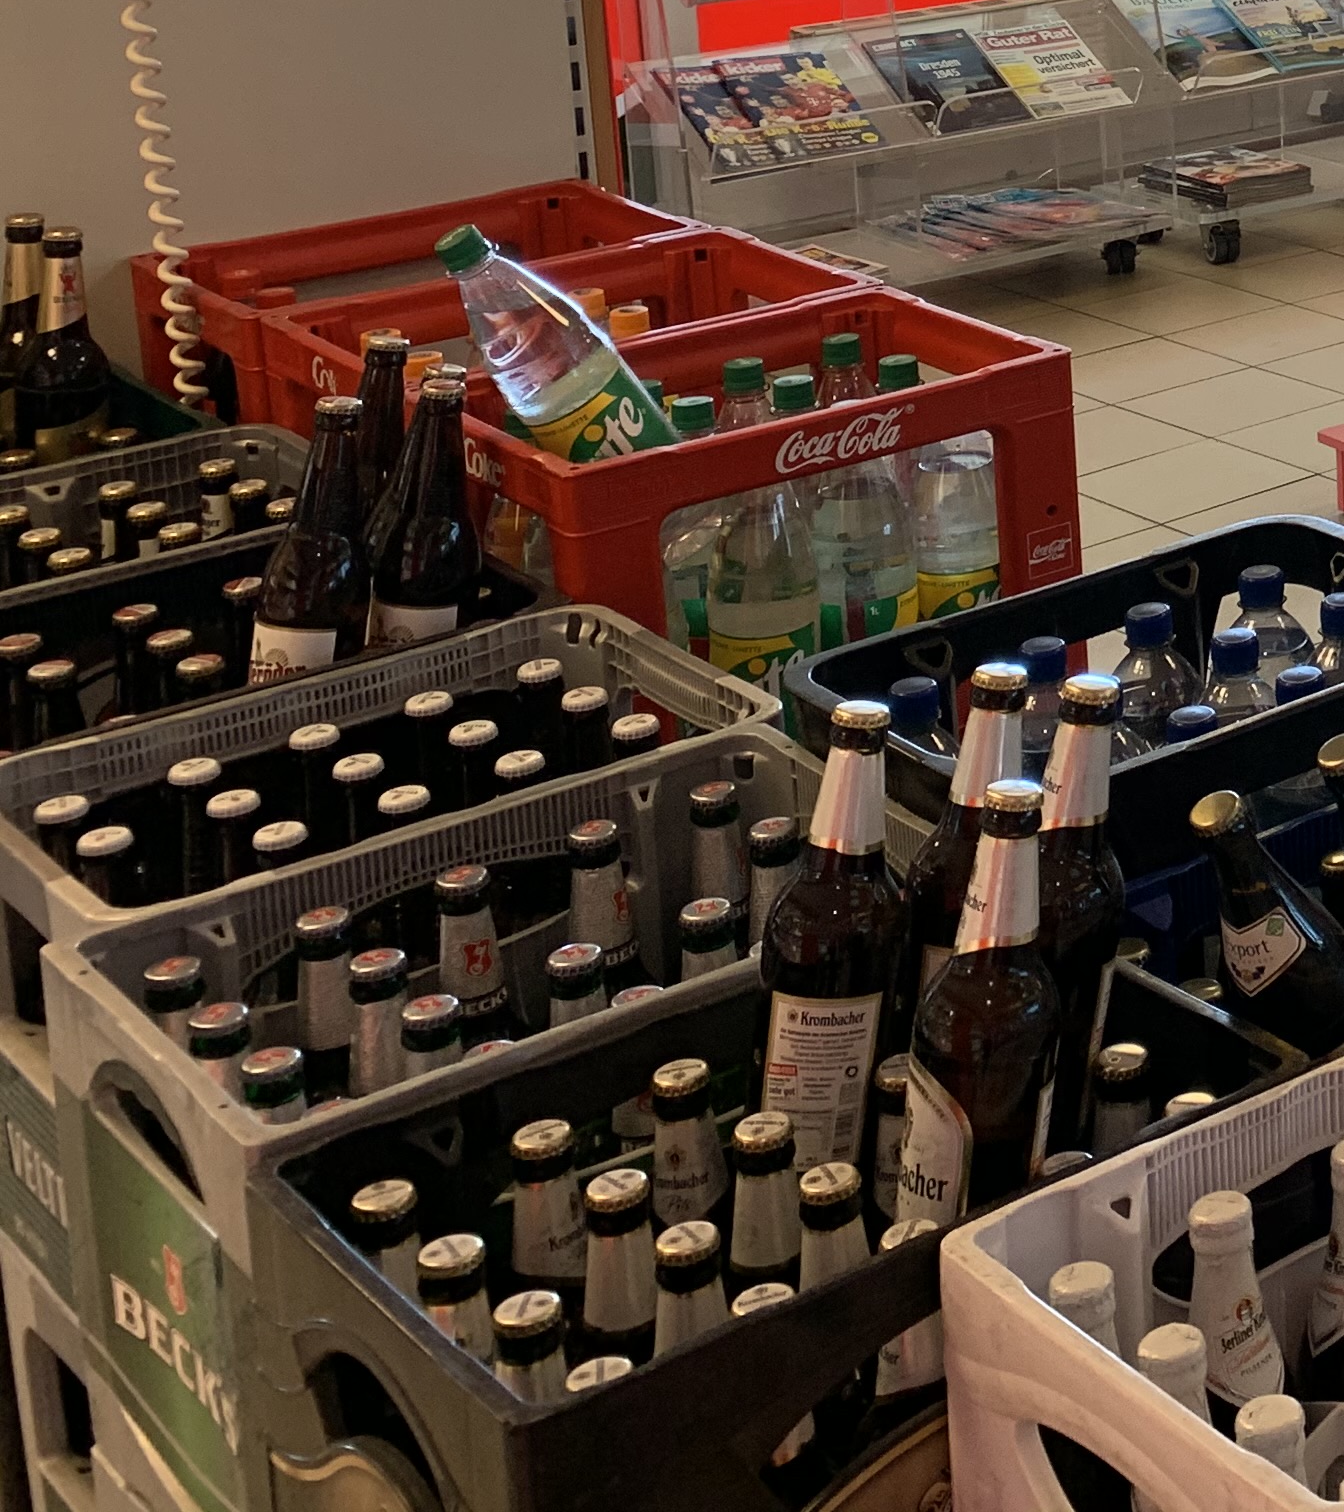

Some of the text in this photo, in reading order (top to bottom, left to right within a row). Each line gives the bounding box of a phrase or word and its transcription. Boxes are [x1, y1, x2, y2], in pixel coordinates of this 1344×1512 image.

[987, 30, 1038, 49] Guter
[1041, 27, 1073, 43] Rat
[1033, 49, 1085, 66] Optimal
[1038, 58, 1097, 75] versichert
[774, 407, 906, 475] Coca-Cola
[464, 435, 501, 485] Coke
[799, 1010, 867, 1028] Krombacher
[110, 1273, 239, 1457] BECK'S
